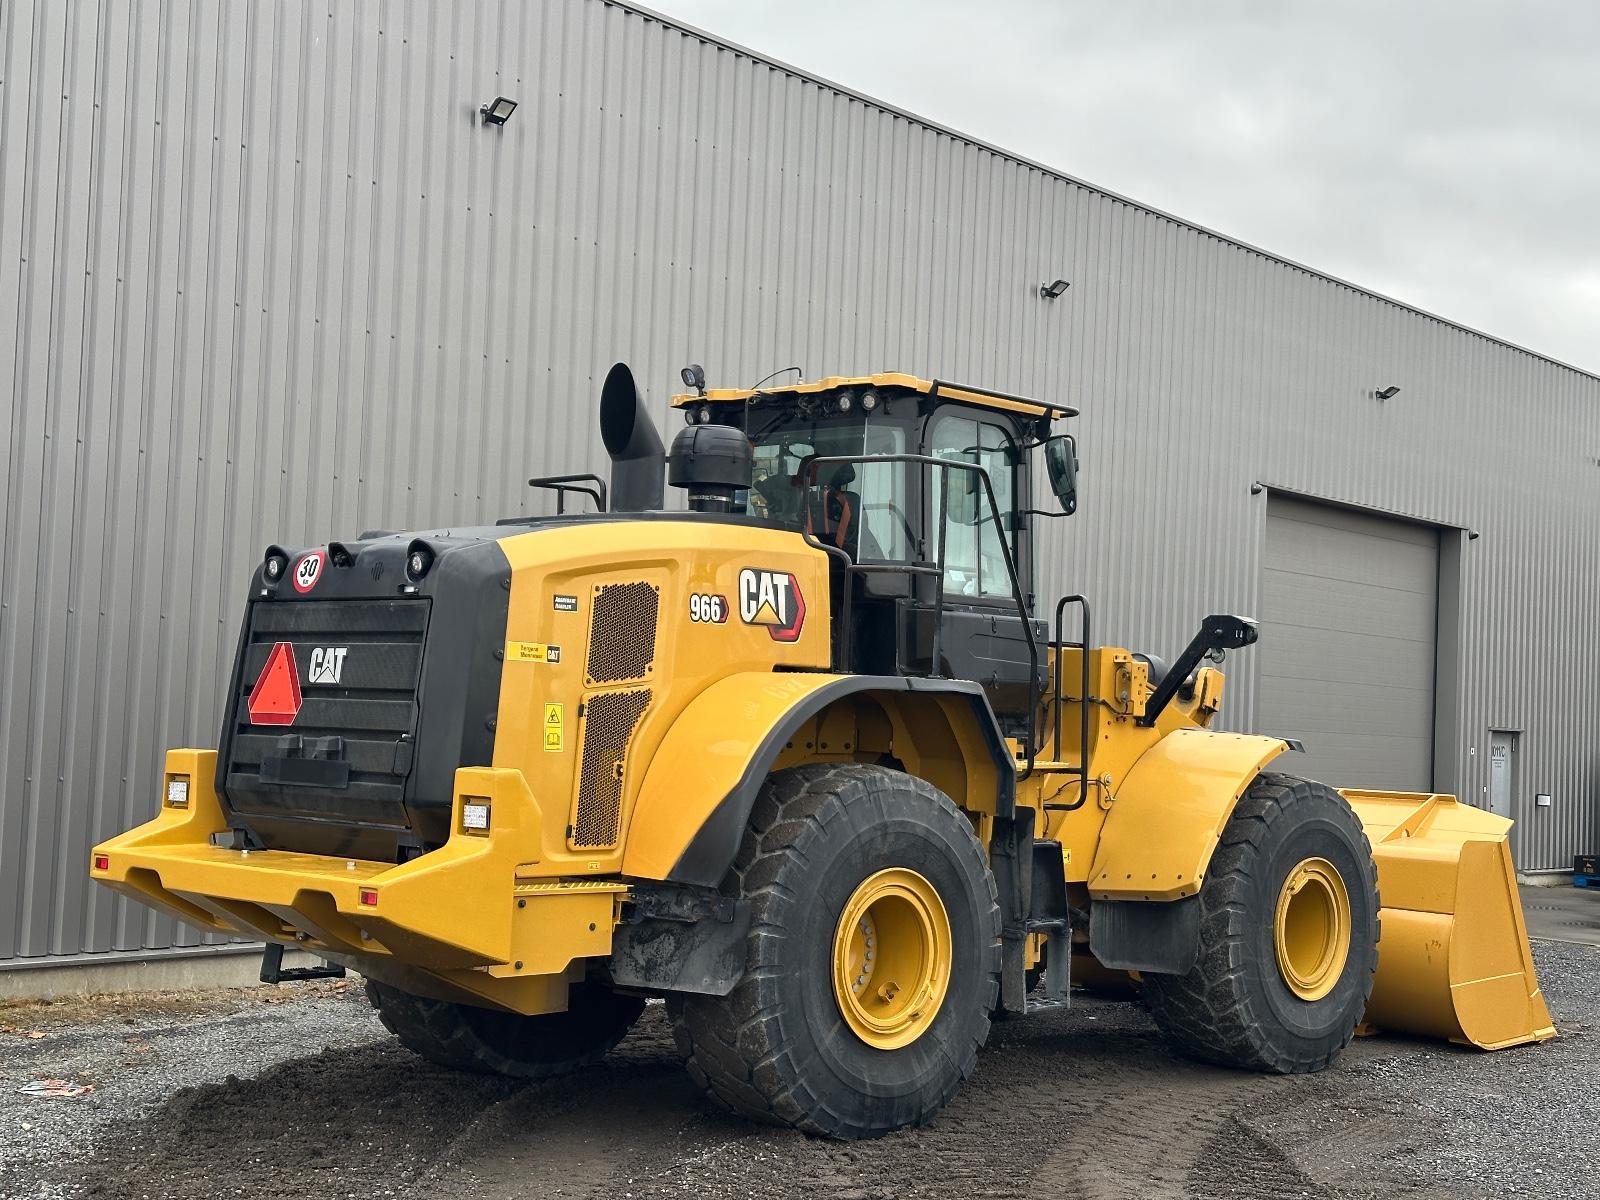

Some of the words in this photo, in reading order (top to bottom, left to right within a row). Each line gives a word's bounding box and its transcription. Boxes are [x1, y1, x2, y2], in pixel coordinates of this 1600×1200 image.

[300, 559, 319, 577] 30
[690, 594, 721, 622] 966
[739, 569, 789, 624] CAT
[308, 647, 348, 683] CAT
[547, 650, 559, 660] CAT
